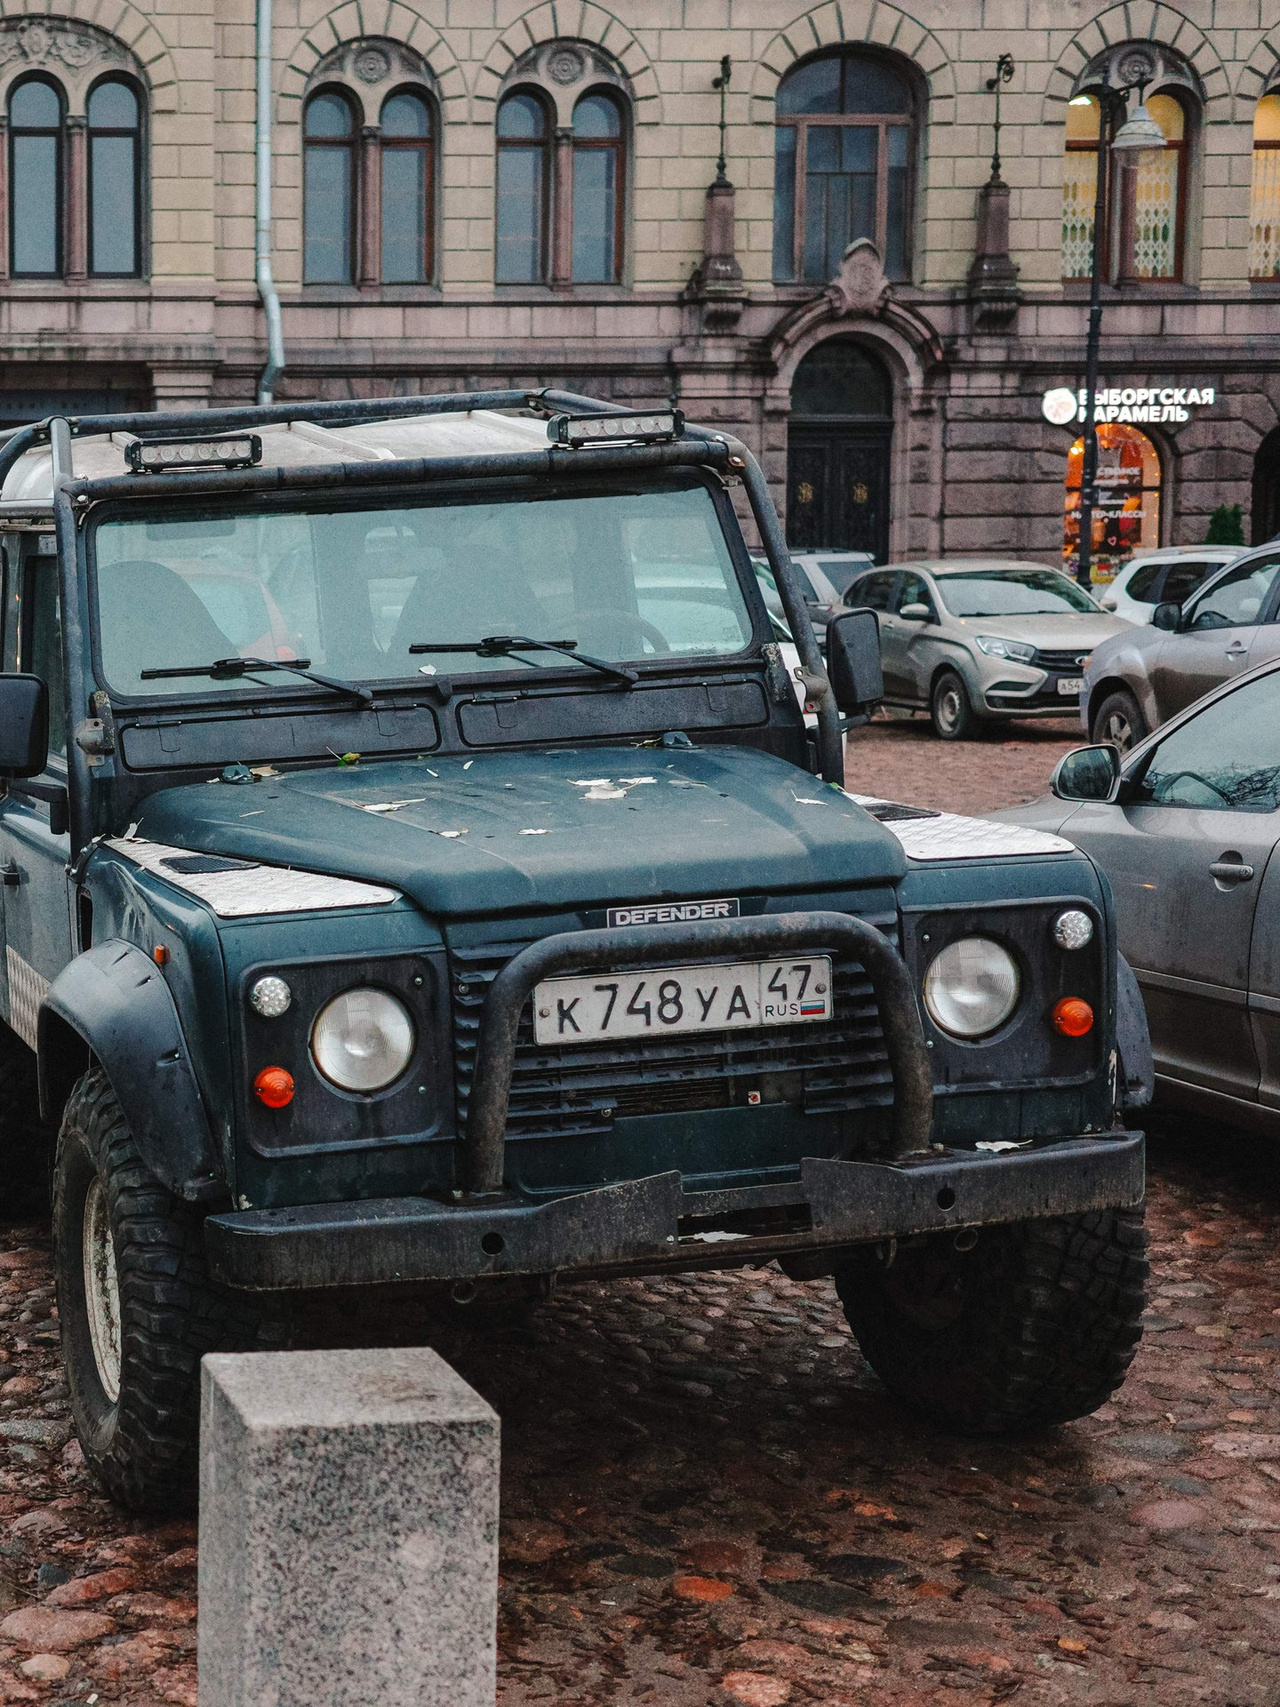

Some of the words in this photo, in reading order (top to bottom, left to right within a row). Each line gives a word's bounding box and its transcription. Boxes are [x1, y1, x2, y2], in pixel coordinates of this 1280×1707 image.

[615, 902, 730, 926] DEFENDER
[768, 964, 812, 1000] 47
[765, 1003, 799, 1018] RUS
